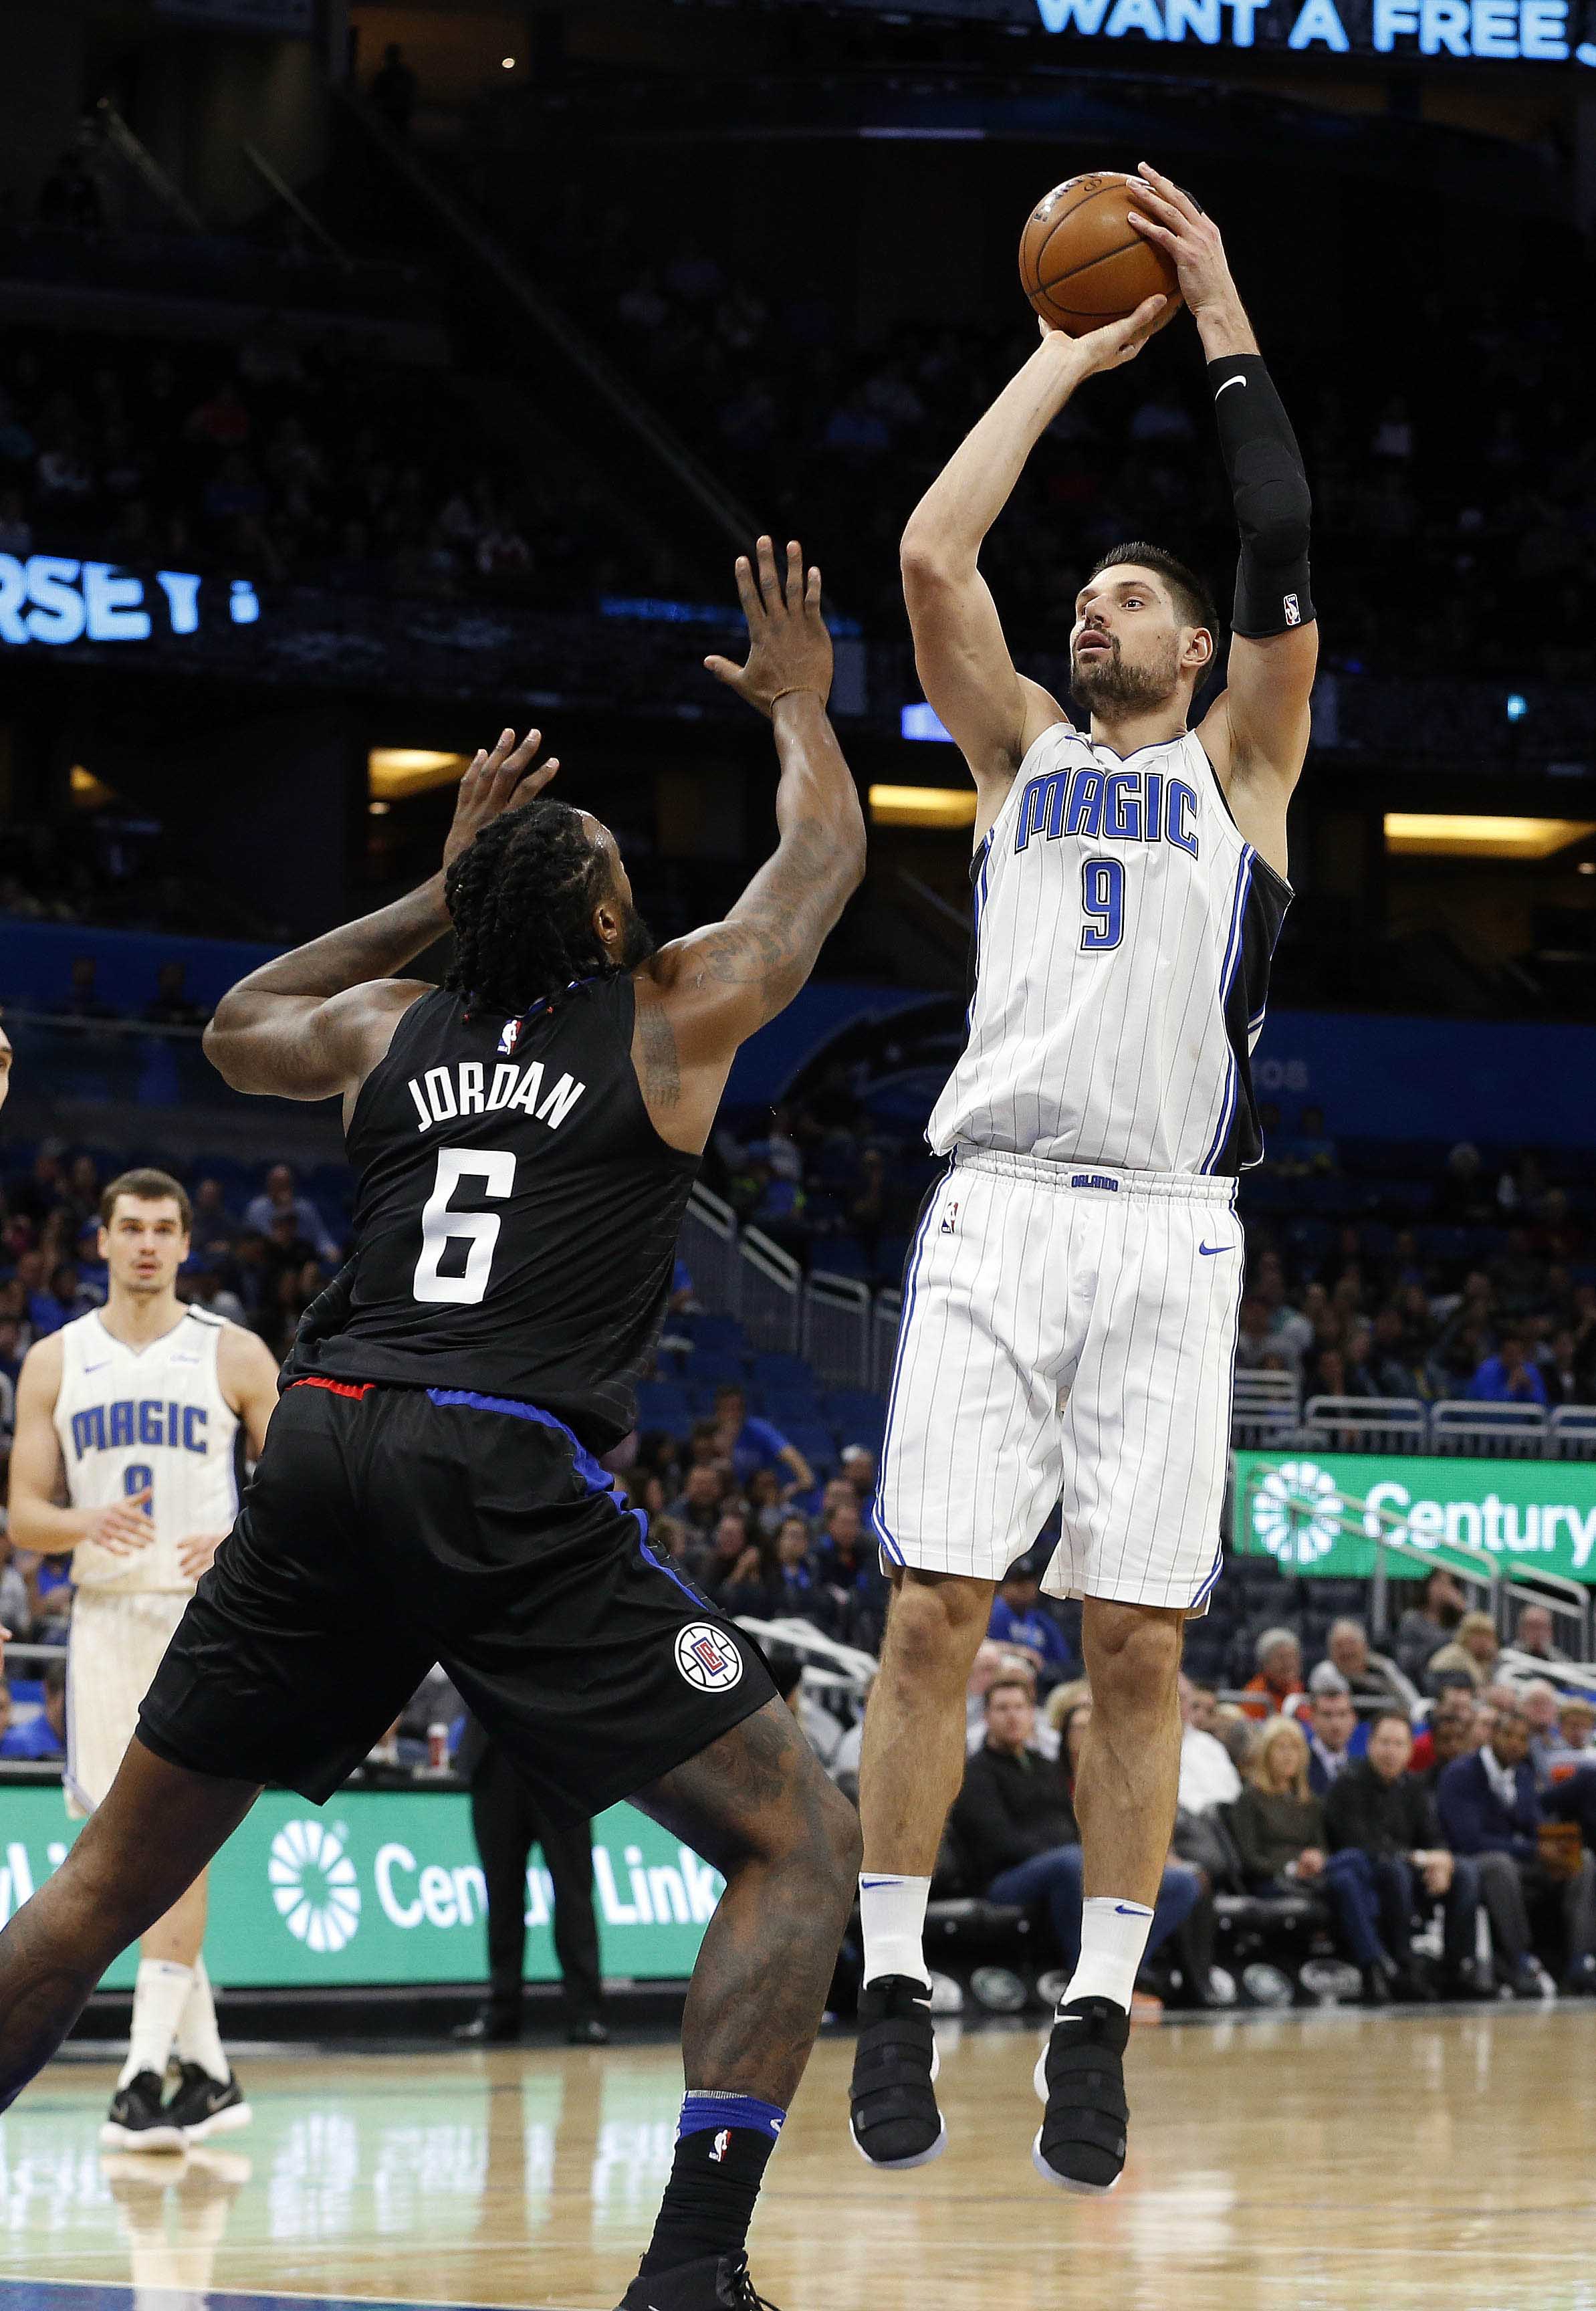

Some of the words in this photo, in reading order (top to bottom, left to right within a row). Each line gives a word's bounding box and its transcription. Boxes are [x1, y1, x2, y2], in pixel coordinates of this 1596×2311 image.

[1036, 0, 1269, 47] WANT
[1288, 0, 1350, 53] A
[1372, 0, 1570, 61] FREE
[1014, 767, 1199, 861] MAGIC
[1080, 857, 1125, 951] 9
[408, 1061, 586, 1132] JORDAN
[1071, 1174, 1119, 1192] ORLANDO
[413, 1147, 517, 1305] 6
[72, 1399, 207, 1461] MAGIC
[1363, 1482, 1596, 1567] Century
